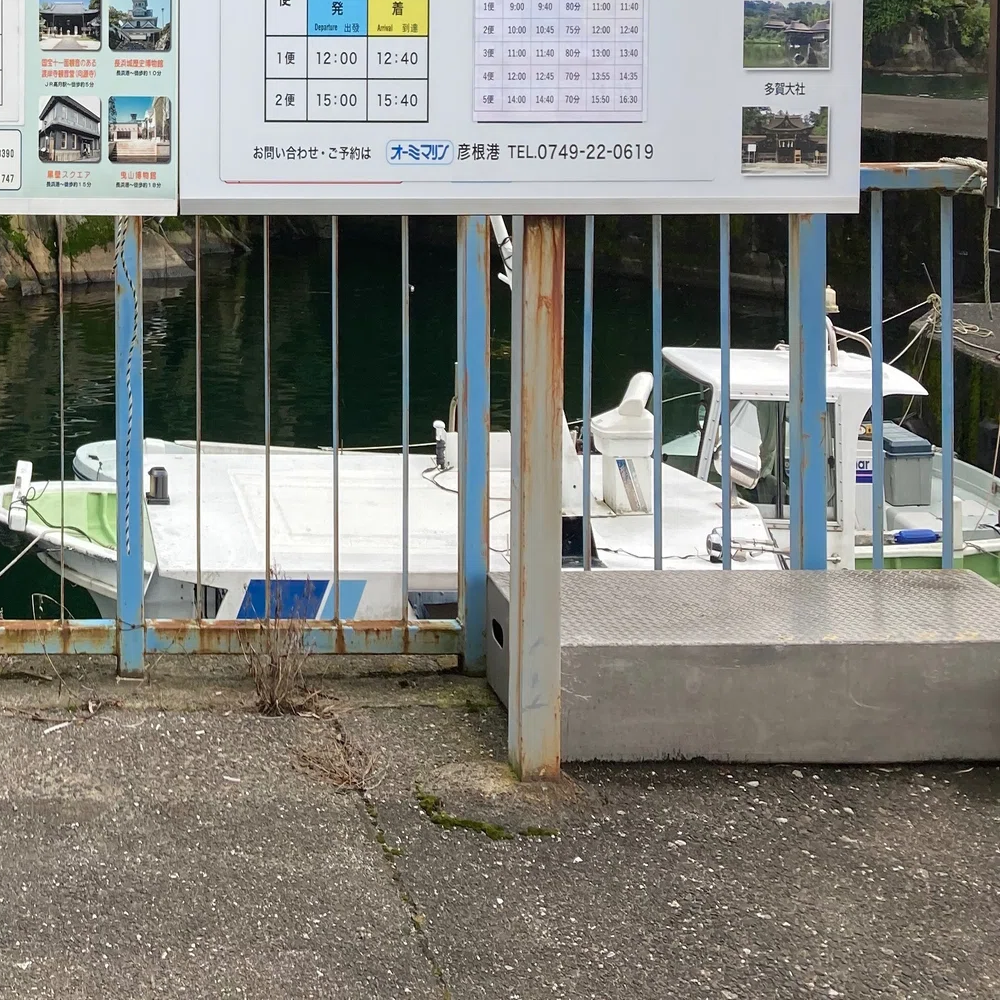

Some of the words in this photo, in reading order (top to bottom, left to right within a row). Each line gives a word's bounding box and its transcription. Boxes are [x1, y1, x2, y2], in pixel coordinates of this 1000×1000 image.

[332, 1, 343, 16] 発
[392, 1, 403, 16] 着
[509, 2, 525, 11] 9:00
[538, 2, 553, 11] 9:40
[592, 2, 611, 11] 11:00
[620, 2, 639, 11] 11:40
[315, 23, 338, 32] Departure
[507, 25, 527, 34] 10:00
[536, 25, 555, 34] 10:45
[592, 25, 611, 34] 12:00
[620, 25, 639, 34] 12:40
[277, 51, 295, 65] 1便
[316, 51, 358, 65] 12:00
[377, 52, 418, 65] 12:40
[507, 49, 527, 58] 11:00
[536, 49, 555, 58] 11:40
[592, 49, 611, 58] 13:00
[620, 49, 639, 58] 13:40
[507, 72, 527, 81] 12:00
[536, 72, 555, 81] 12:45
[592, 72, 611, 81] 13:55
[620, 72, 639, 81] 14:35
[764, 82, 806, 96] 多賀大社
[275, 93, 295, 107] 2便
[316, 94, 357, 107] 15:00
[377, 94, 418, 107] 15:40
[507, 95, 527, 104] 14:00
[536, 95, 555, 104] 14:40
[592, 95, 611, 104] 15:50
[620, 95, 639, 104] 16:30
[253, 146, 371, 160] お問い合わせ・ご予約は
[391, 144, 450, 160] オーミマリン
[457, 143, 500, 161] 彦根港
[508, 144, 654, 160] TEL.0749-22-0619
